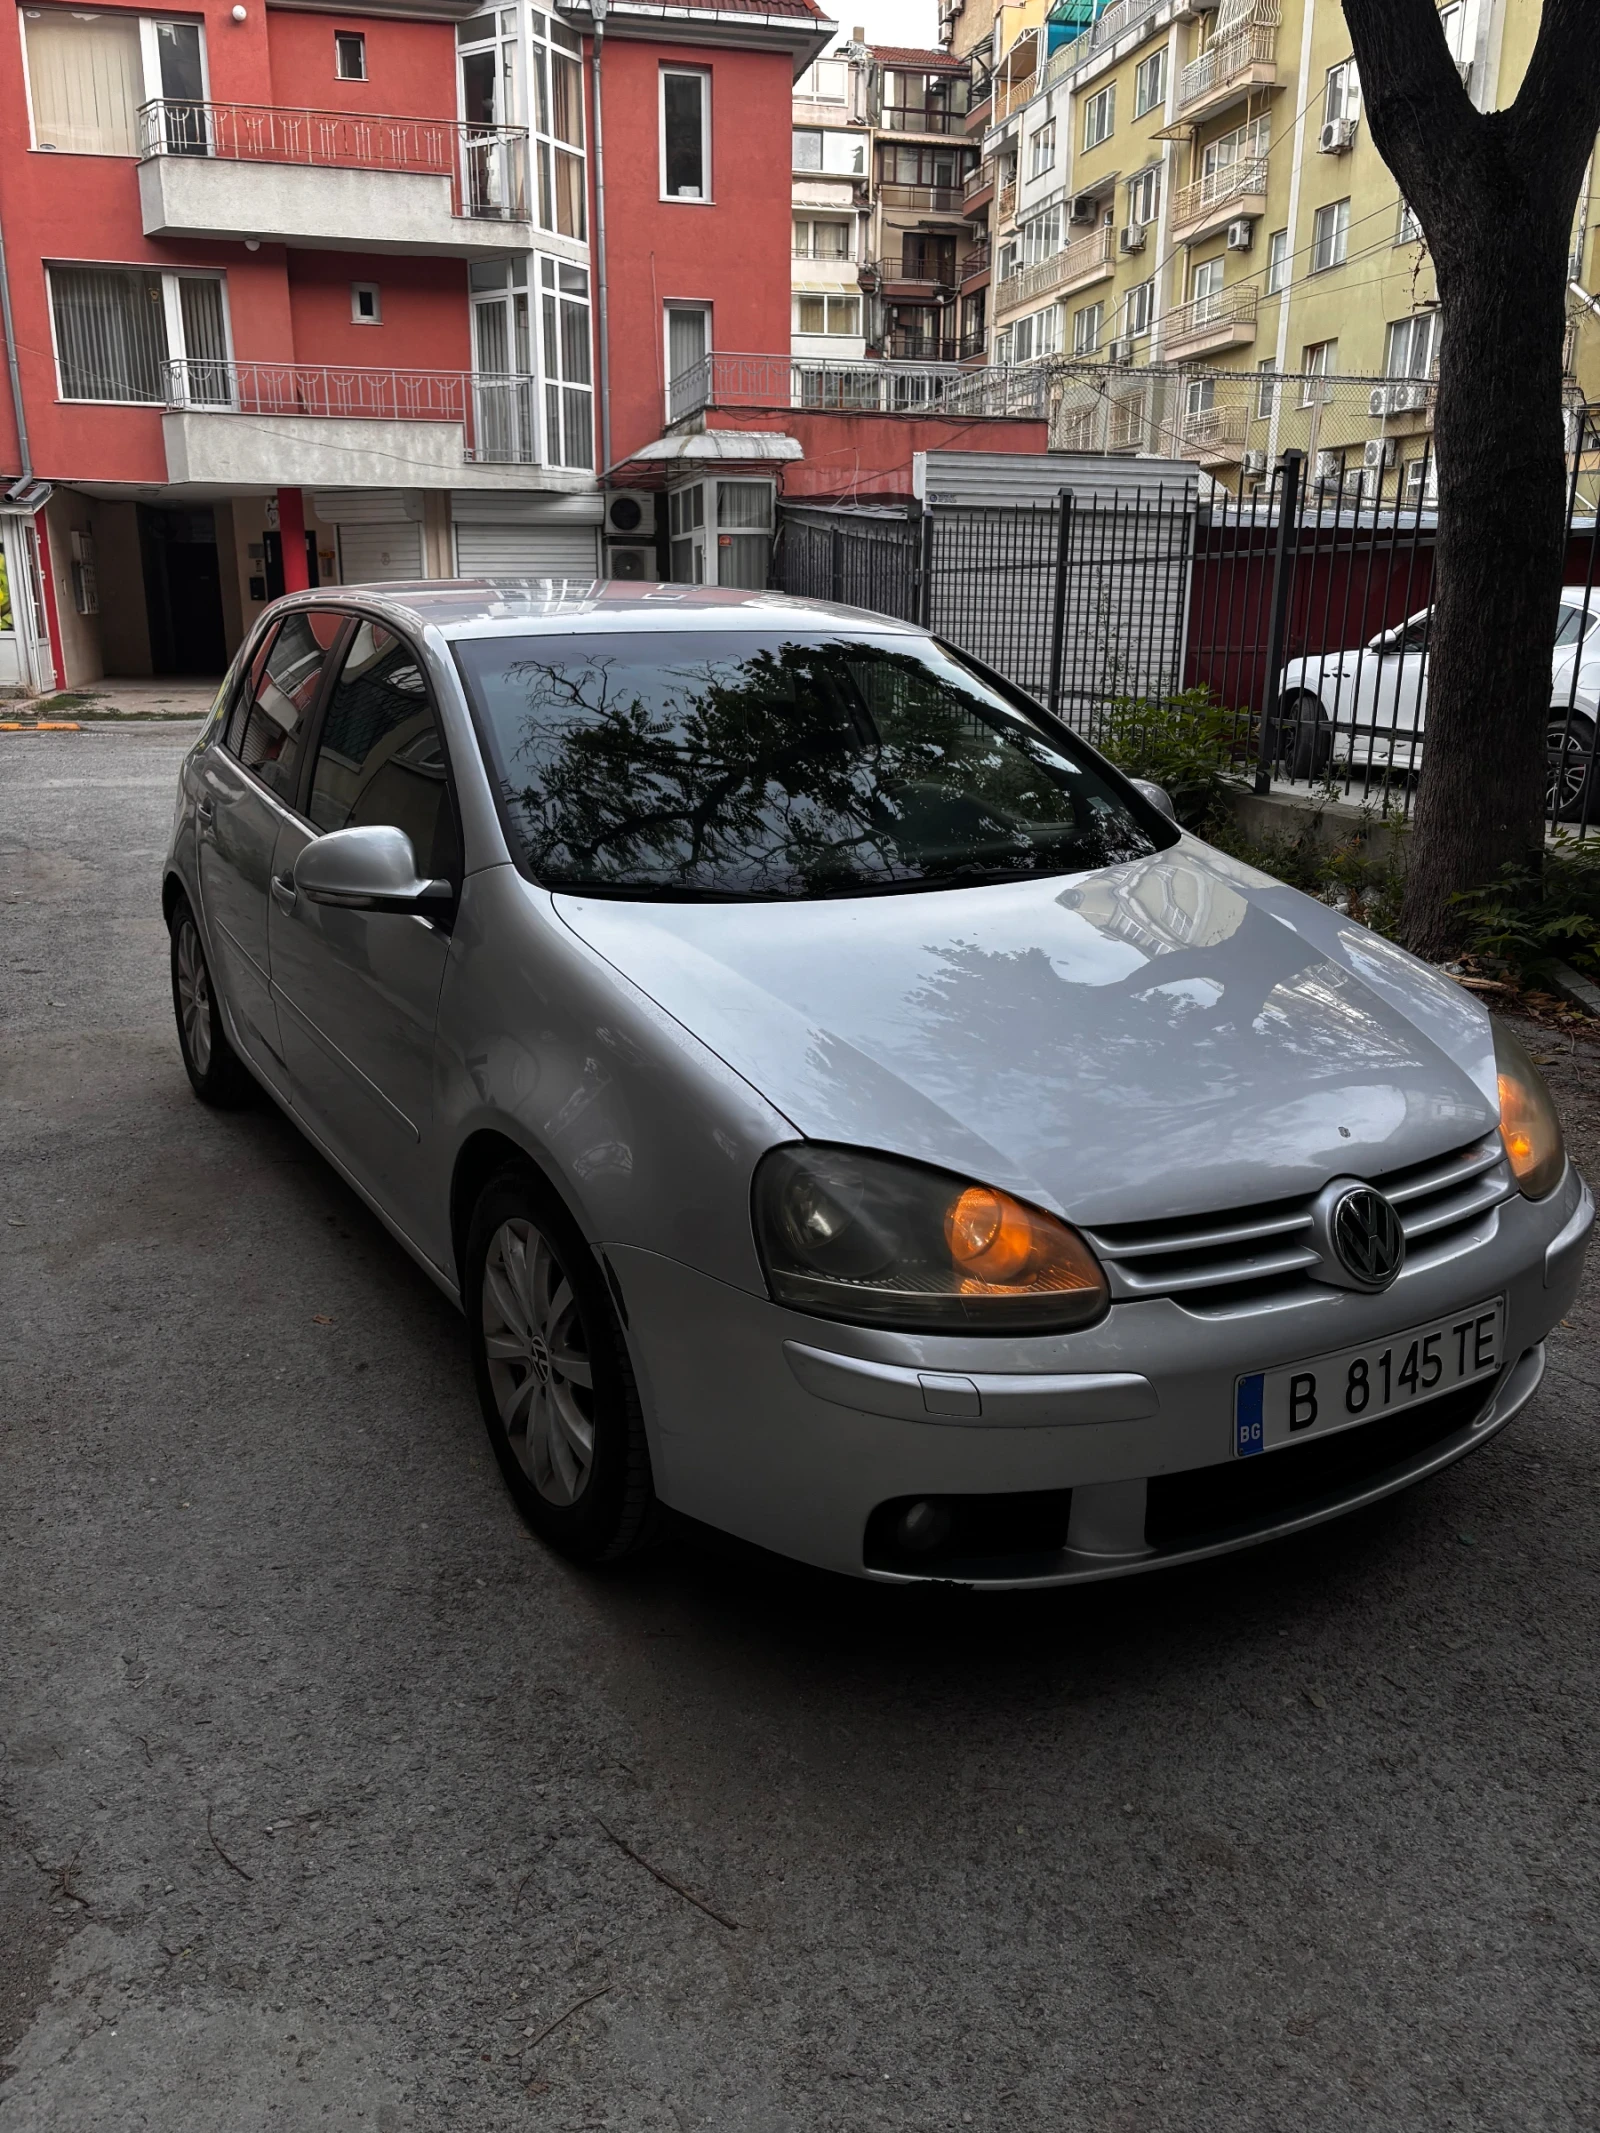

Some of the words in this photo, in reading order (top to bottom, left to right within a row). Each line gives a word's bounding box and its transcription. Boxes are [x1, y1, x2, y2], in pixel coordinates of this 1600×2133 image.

[1289, 1372, 1318, 1432] B
[1345, 1331, 1443, 1414] 8145
[1452, 1311, 1496, 1377] TE
[1240, 1422, 1261, 1444] BG
